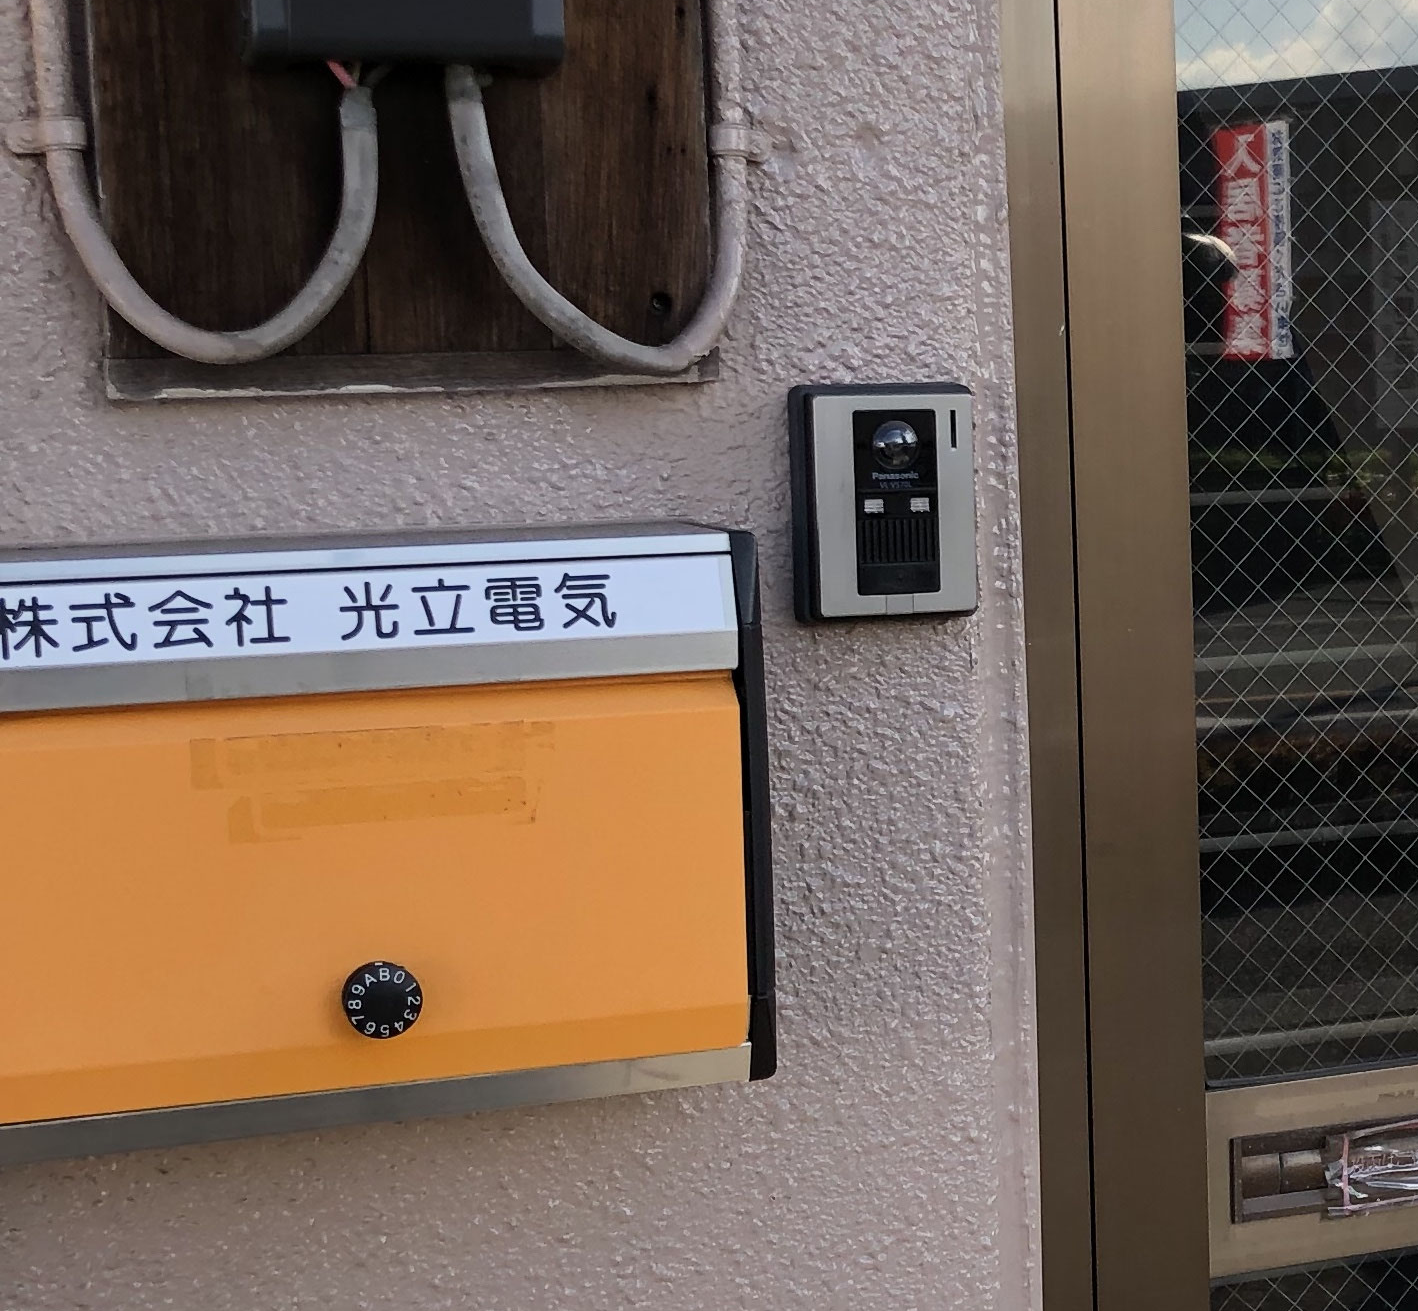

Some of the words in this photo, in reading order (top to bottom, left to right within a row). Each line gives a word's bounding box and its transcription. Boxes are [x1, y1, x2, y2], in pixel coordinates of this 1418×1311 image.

[872, 471, 919, 480] Panasonic
[0, 586, 292, 660] 株式会社
[339, 572, 618, 642] 光立電気
